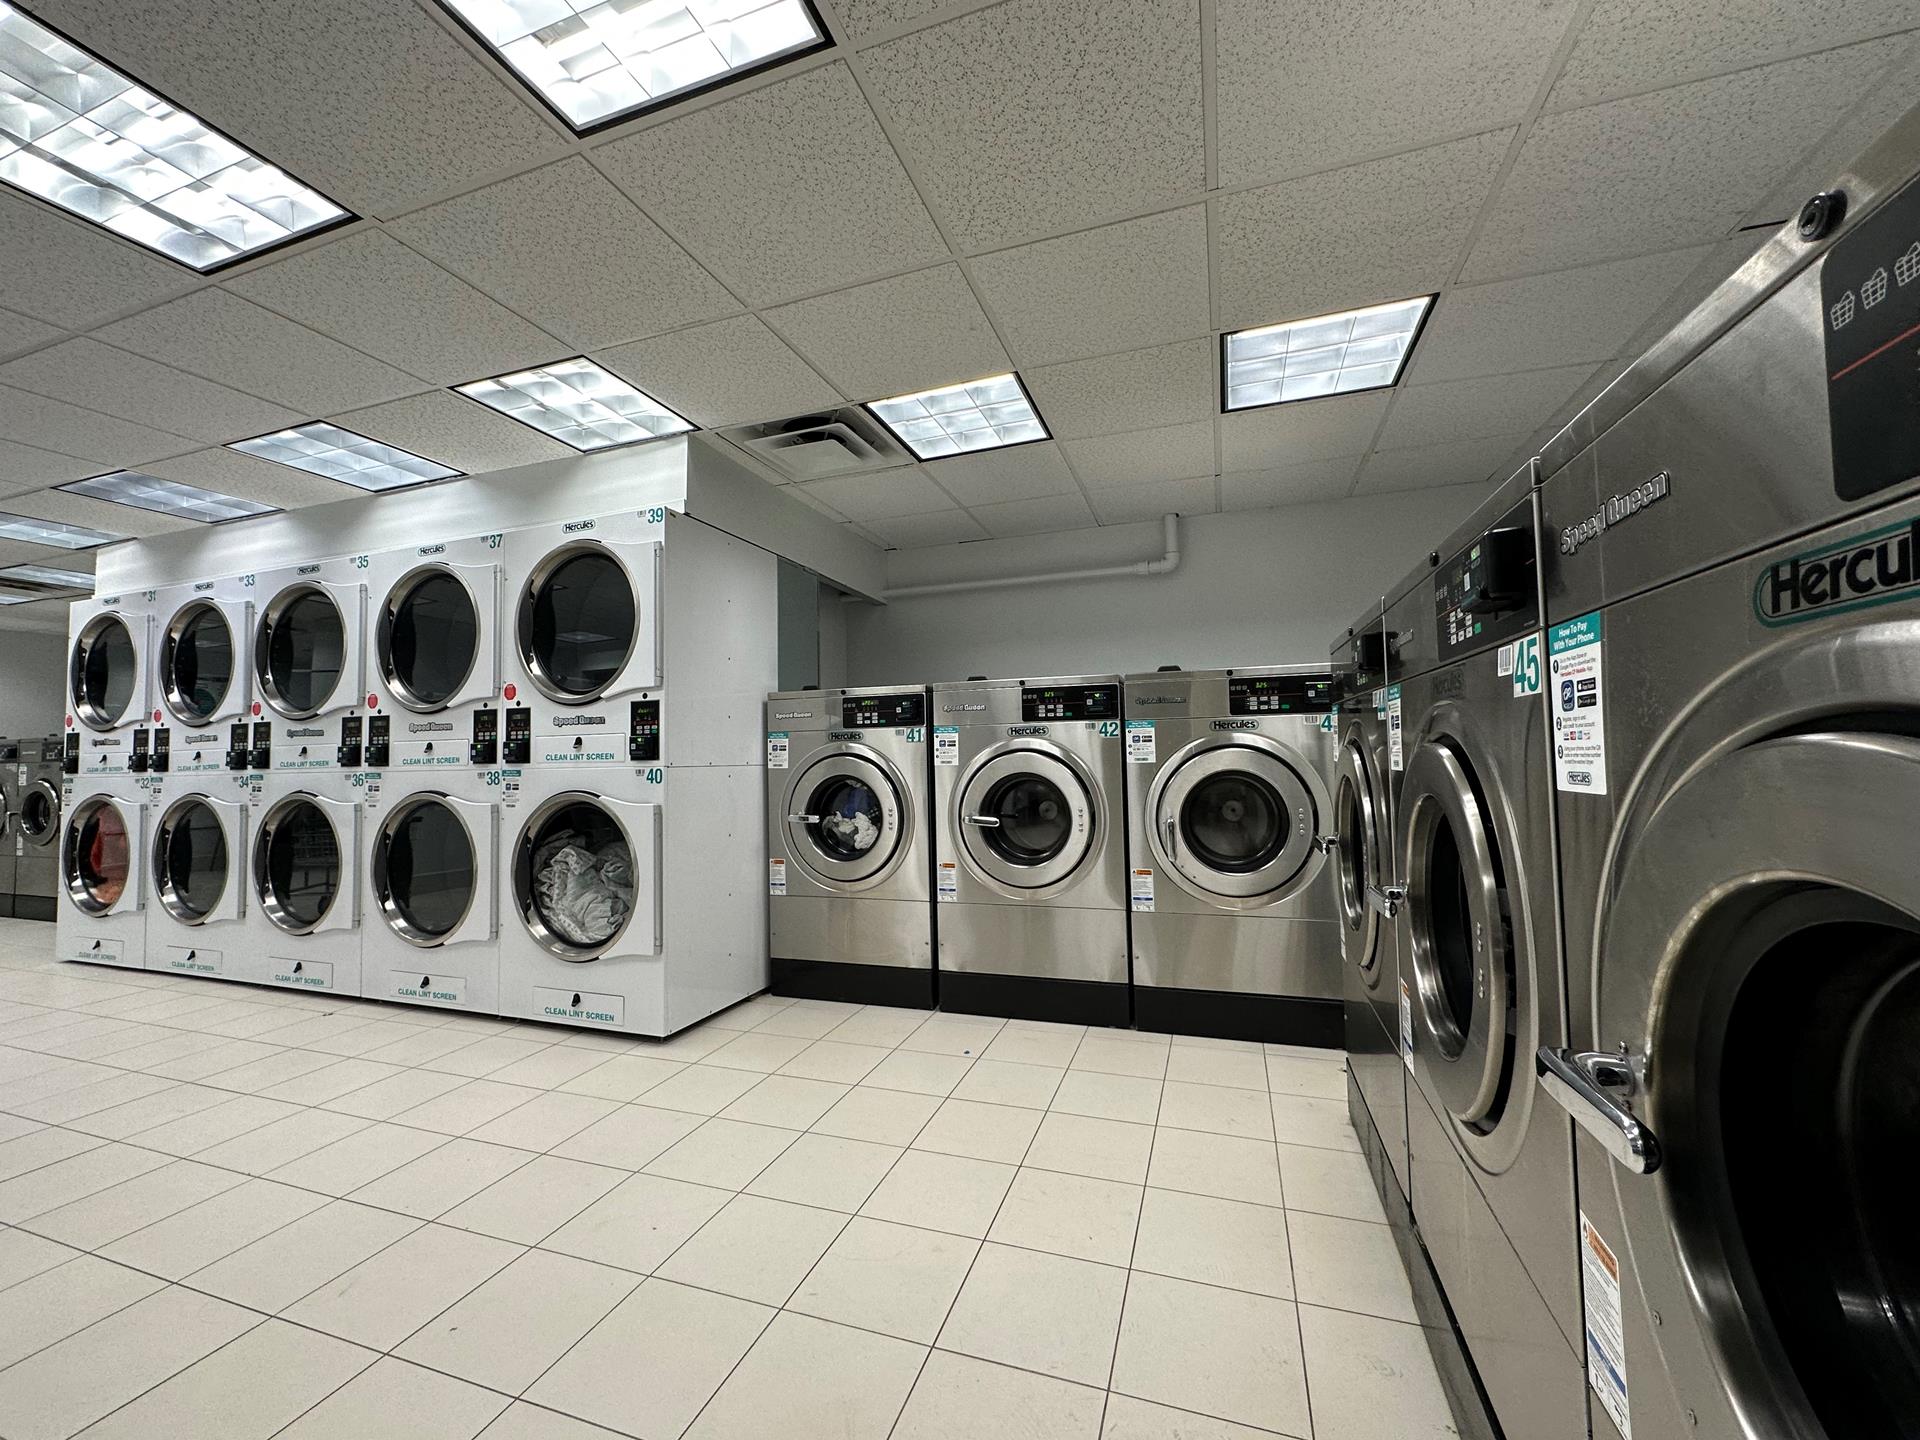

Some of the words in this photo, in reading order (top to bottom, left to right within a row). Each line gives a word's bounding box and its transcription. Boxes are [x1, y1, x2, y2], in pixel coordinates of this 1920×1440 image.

[648, 508, 664, 524] 39
[1560, 503, 1605, 555] Speed
[1606, 471, 1671, 527] Queen
[564, 520, 594, 533] Hercules
[489, 534, 503, 549] 37
[419, 544, 445, 556] Hercules
[357, 555, 369, 569] 35
[244, 575, 255, 587] 33
[148, 591, 156, 602] 31
[1559, 628, 1571, 638] How
[1571, 625, 1577, 634] To
[1577, 622, 1587, 632] Pay
[1553, 639, 1565, 651] With
[1565, 636, 1577, 647] Your
[1577, 632, 1595, 643] Phone
[1514, 637, 1540, 693] 45
[553, 716, 578, 727] Speed
[775, 712, 793, 720] Speed
[409, 723, 431, 733] Speed
[1010, 727, 1046, 736] Hercules
[1099, 722, 1119, 737] 42
[1213, 720, 1256, 730] Hercules
[830, 732, 862, 741] Hercules
[906, 728, 922, 742] 41
[436, 756, 460, 764] SCREEN
[545, 753, 568, 761] CLEAN
[569, 753, 584, 761] LINT
[586, 752, 615, 760] SCREEN
[240, 776, 249, 788] 34
[352, 774, 364, 787] 36
[487, 771, 500, 786] 38
[646, 768, 663, 784] 40
[140, 778, 150, 789] 32
[275, 974, 291, 983] CLEAN
[292, 976, 303, 984] LINT
[303, 977, 325, 986] SCREEN
[398, 988, 417, 997] CLEAN
[418, 990, 431, 998] LINT
[432, 992, 457, 1001] SCREEN
[544, 1006, 567, 1017] CLEAN
[568, 1009, 584, 1018] LINT
[585, 1010, 615, 1022] SCREEN
